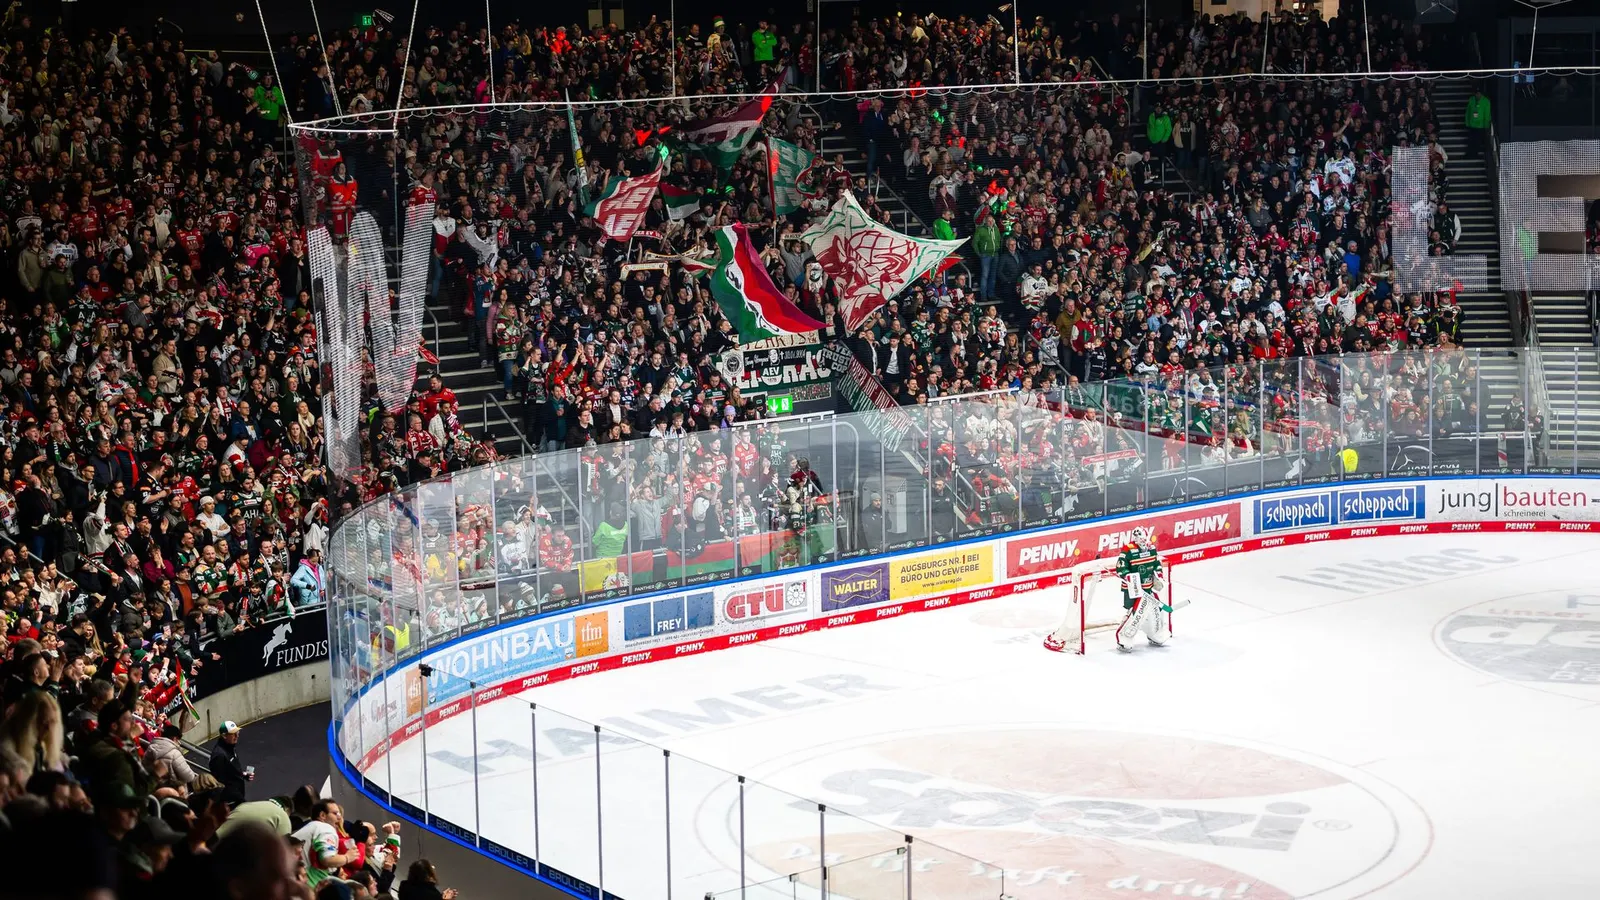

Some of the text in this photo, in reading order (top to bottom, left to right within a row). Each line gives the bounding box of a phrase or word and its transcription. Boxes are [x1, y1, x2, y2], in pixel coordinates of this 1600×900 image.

[763, 366, 779, 376] AEV
[1266, 494, 1325, 527] scheppach
[1344, 488, 1409, 520] scheppach
[1439, 486, 1587, 514] jung bauten
[1504, 509, 1546, 517] schreinerei
[900, 558, 948, 574] AUGSBURGS
[948, 556, 962, 566] NR.
[967, 553, 980, 563] BEI
[900, 563, 980, 584] BÜRO UND GEWERBE
[726, 583, 784, 619] GTÜ
[834, 579, 878, 597] WALTER
[581, 621, 602, 642] tfm
[657, 618, 682, 632] FREY
[276, 640, 328, 667] FUNDIS
[427, 619, 574, 689] WOHNBAU
[430, 672, 903, 777] HAIMER
[786, 768, 1312, 852] Spezi
